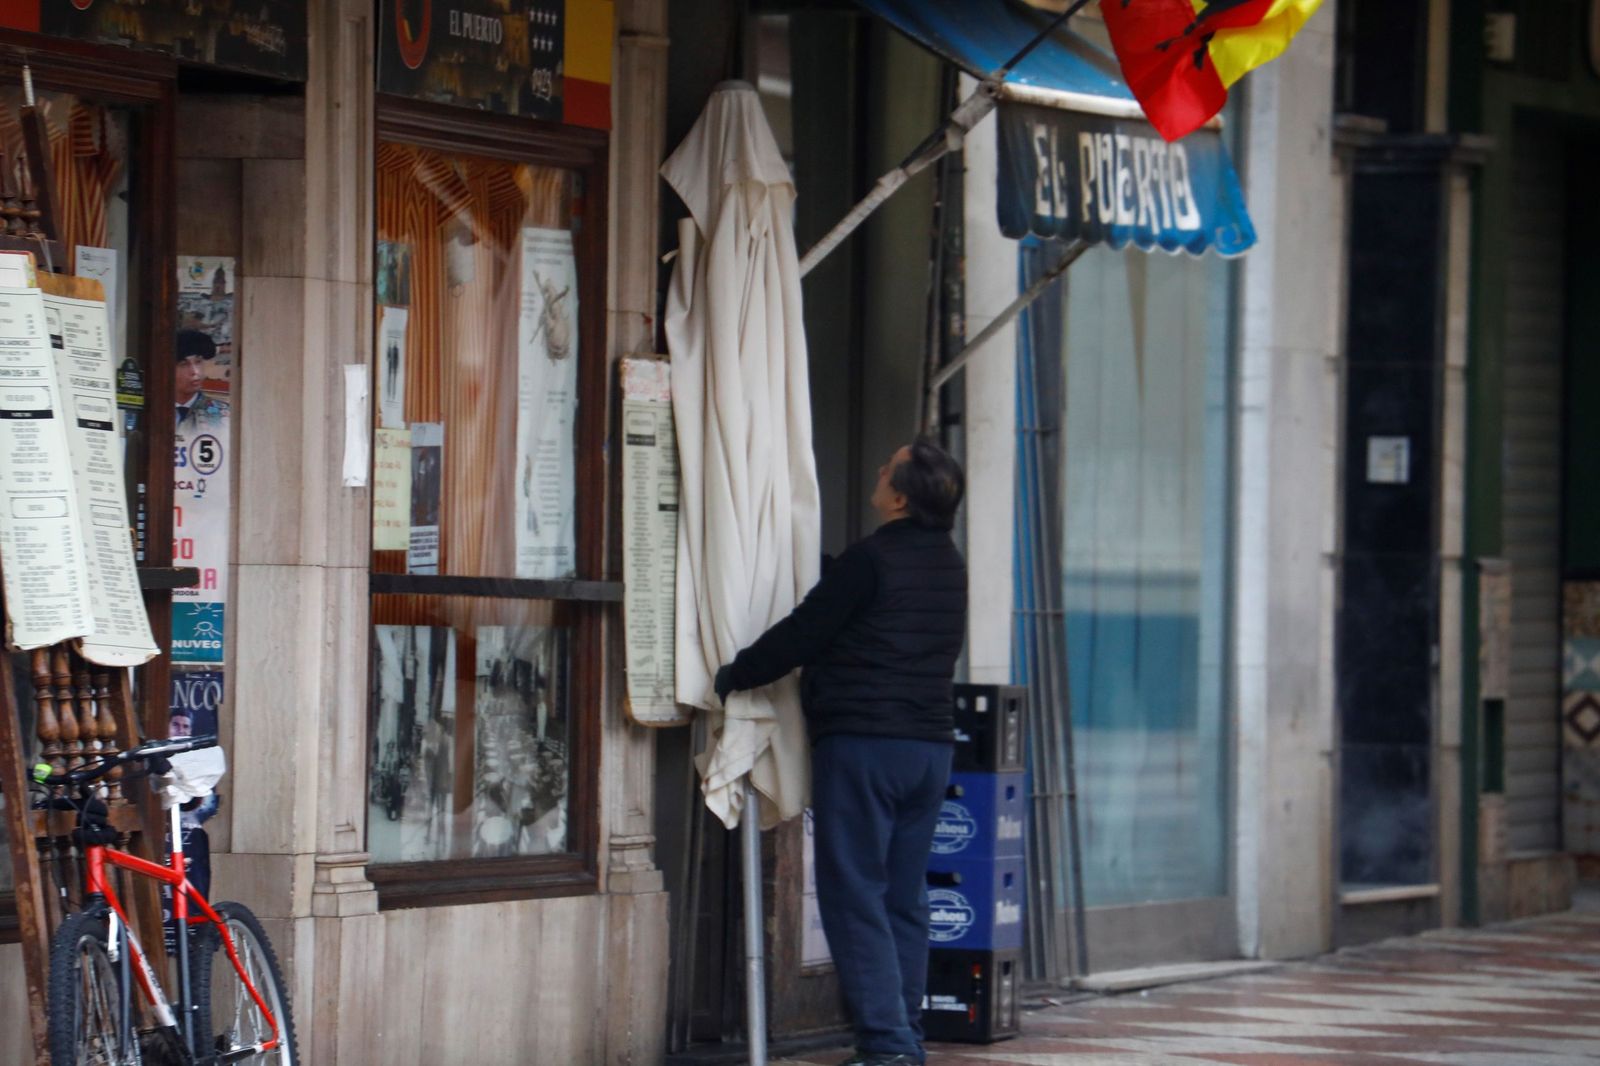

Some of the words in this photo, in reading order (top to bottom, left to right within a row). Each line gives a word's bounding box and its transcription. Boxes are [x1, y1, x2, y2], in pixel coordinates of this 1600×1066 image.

[450, 10, 461, 36] EL
[462, 12, 503, 45] PUERTO
[1033, 123, 1068, 219] EL
[1077, 131, 1201, 235] PUERTO
[199, 440, 214, 463] 5
[172, 640, 222, 649] NUVEG
[930, 908, 967, 922] ahou
